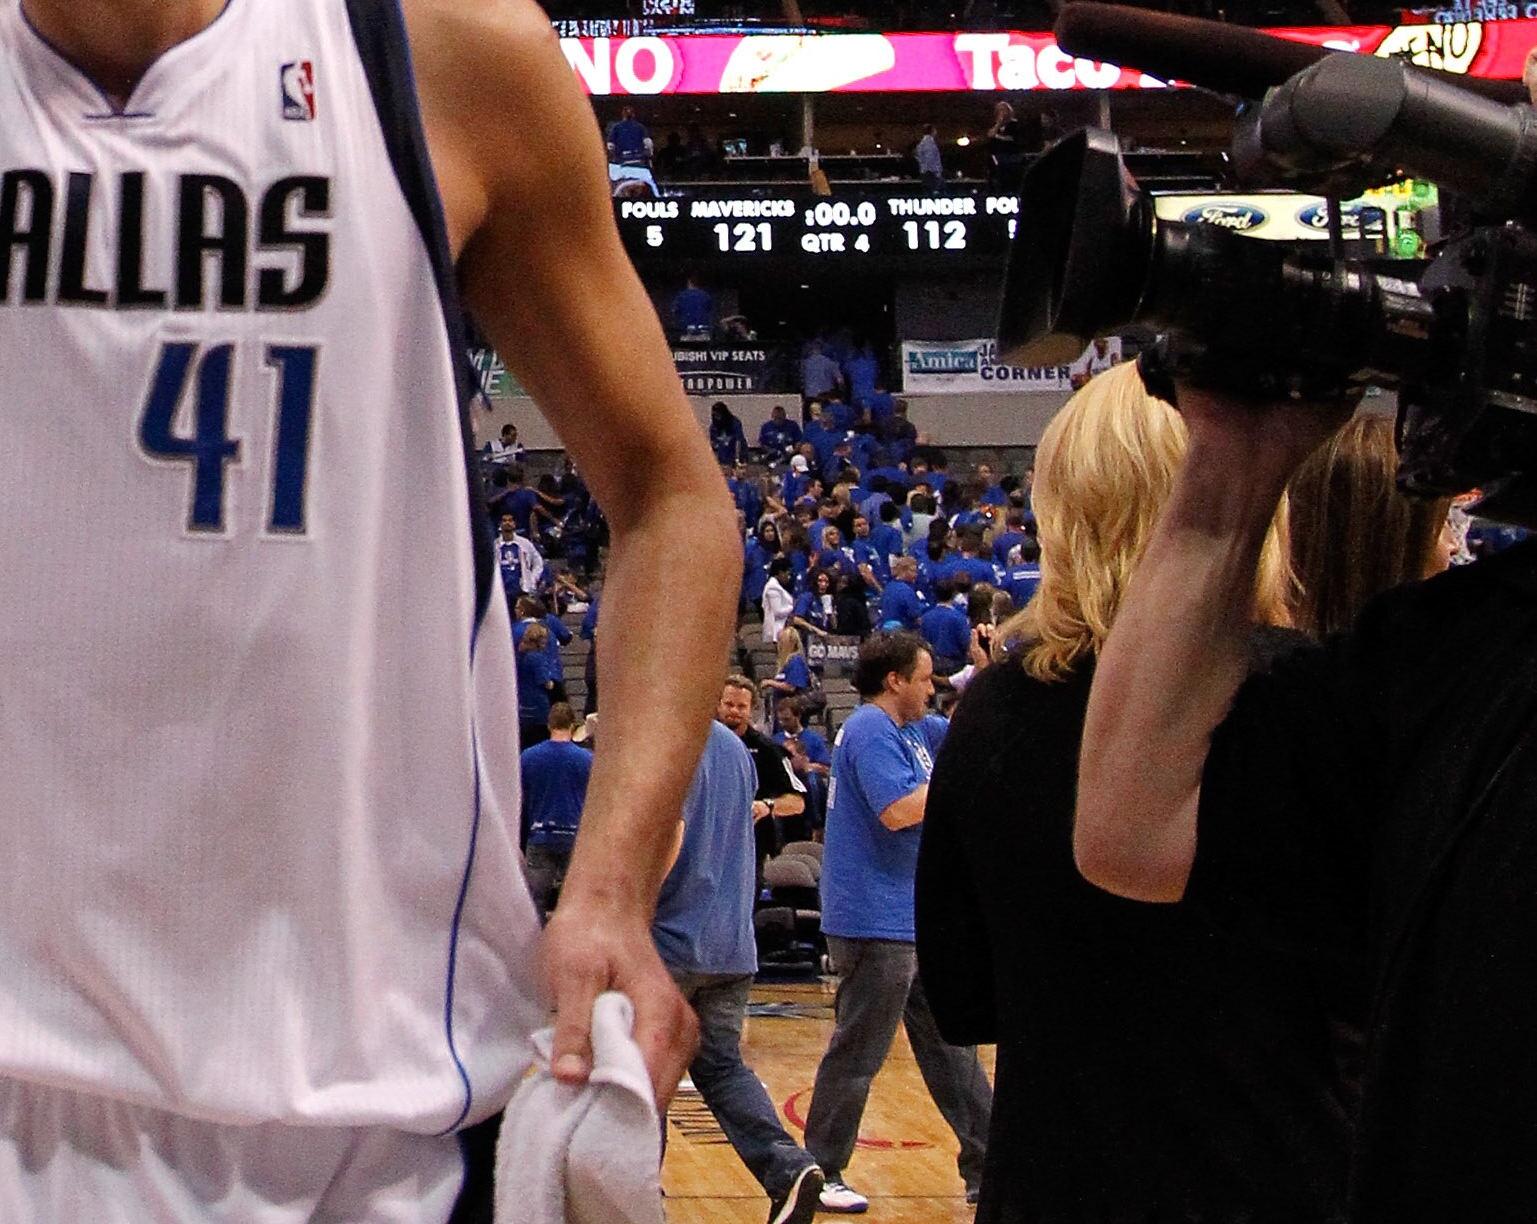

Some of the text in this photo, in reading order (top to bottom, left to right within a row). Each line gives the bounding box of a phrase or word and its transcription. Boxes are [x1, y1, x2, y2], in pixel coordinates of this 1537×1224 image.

[622, 202, 679, 219] FOULS
[690, 199, 795, 218] MAVERICKS
[888, 197, 976, 217] THUNDER
[646, 226, 663, 247] 5
[713, 223, 772, 251] 121
[800, 233, 870, 253] QTR 4
[903, 220, 966, 250] 112
[710, 351, 729, 361] VIP
[732, 350, 766, 361] SEATS
[911, 351, 976, 372] Amica
[980, 365, 1070, 380] CORNER
[136, 341, 323, 539] 41
